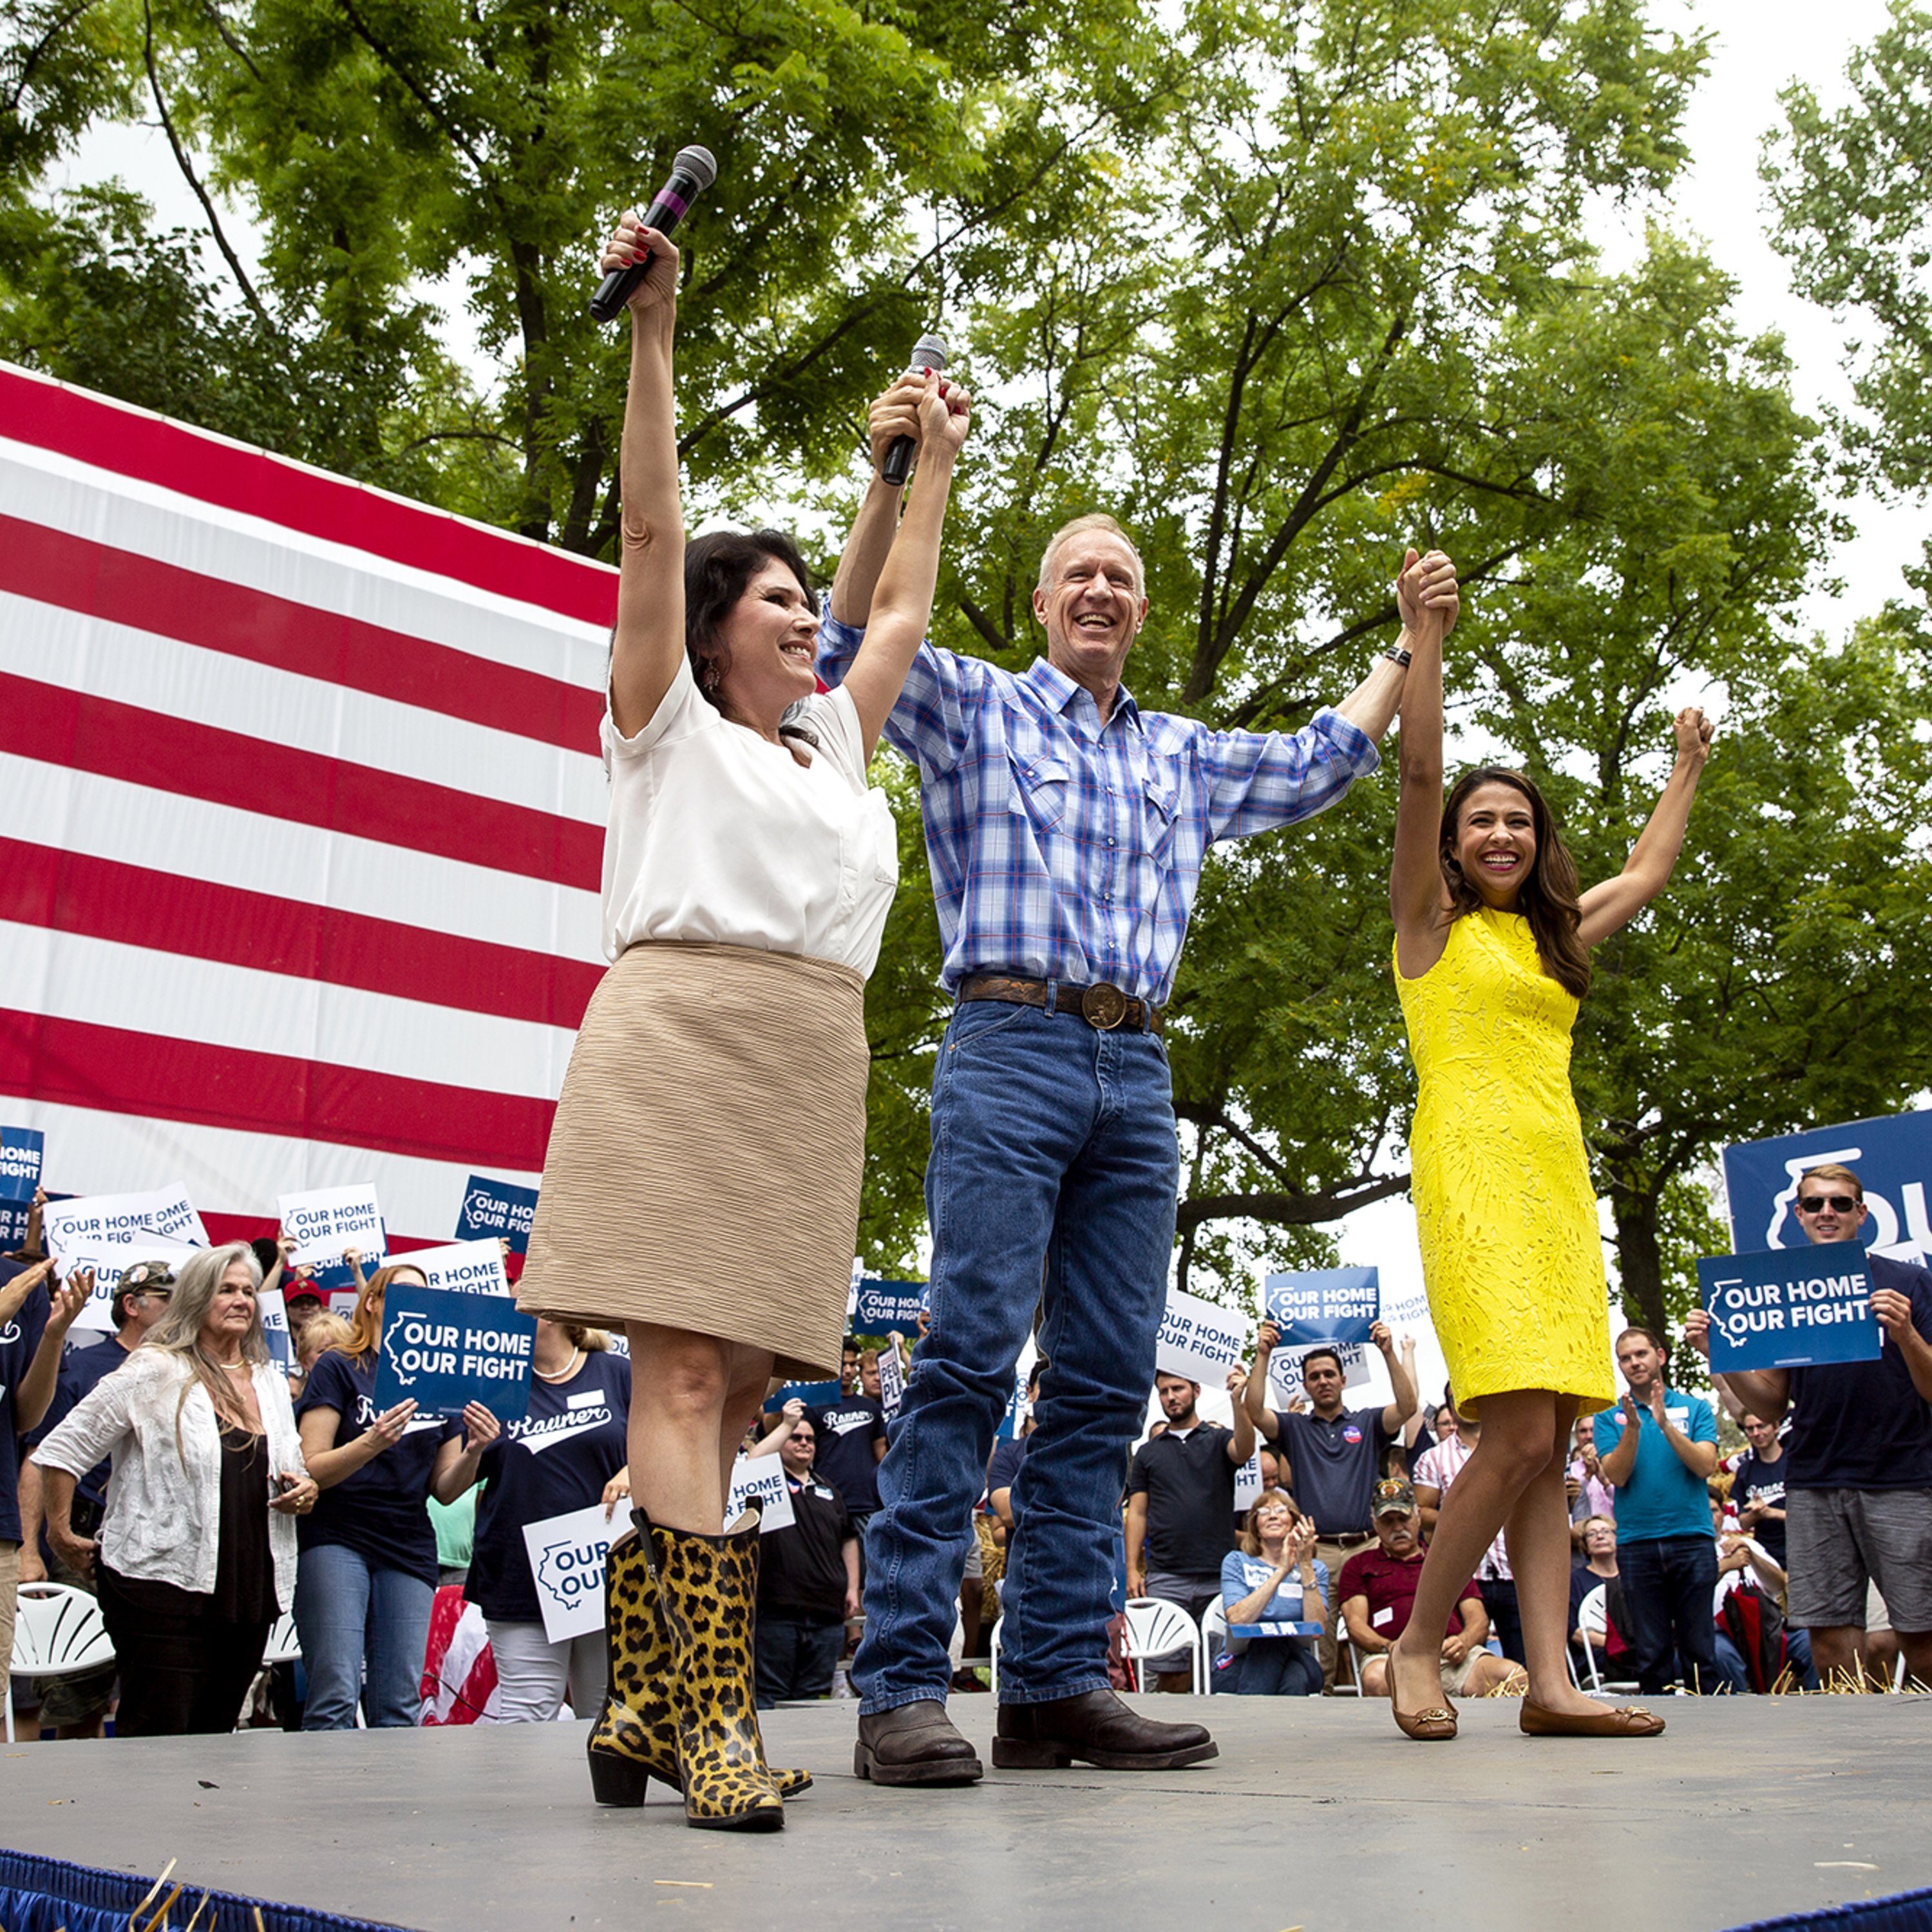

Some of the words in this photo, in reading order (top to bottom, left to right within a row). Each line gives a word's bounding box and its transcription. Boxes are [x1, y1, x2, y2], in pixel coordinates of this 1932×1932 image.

[0, 1161, 39, 1180] IGHT
[156, 1199, 190, 1222] OME
[296, 1209, 329, 1225] OUR
[334, 1202, 376, 1219] HOME
[476, 1196, 509, 1215] OUR
[511, 1204, 534, 1219] HO
[62, 1218, 100, 1234] OUR
[106, 1213, 153, 1229] HOME
[298, 1224, 332, 1240] OUR
[336, 1217, 377, 1234] FIGHT
[473, 1210, 506, 1228] OUR
[507, 1218, 531, 1233] FIG
[446, 1262, 499, 1283] HOME
[867, 1295, 896, 1308] OUR
[1279, 1290, 1319, 1306] OUR
[1323, 1288, 1377, 1303] HOME
[1395, 1294, 1426, 1311] HOM
[1725, 1283, 1782, 1309] OUR
[1786, 1273, 1868, 1302] HOME
[866, 1307, 895, 1320] OUR
[896, 1309, 921, 1320] FIGH
[1280, 1306, 1320, 1321] OUR
[1324, 1304, 1377, 1320] FIGHT
[1400, 1306, 1429, 1321] FIGH
[1728, 1309, 1785, 1334] OUR
[1791, 1299, 1870, 1328] FIGHT
[404, 1322, 459, 1349] OUR
[464, 1329, 532, 1356] HOME
[1162, 1311, 1193, 1332] OUR
[1195, 1323, 1240, 1351] HOME
[1157, 1327, 1187, 1349] OUR
[1190, 1340, 1236, 1366] FIGHT
[1330, 1343, 1361, 1353] OME
[401, 1349, 457, 1374] OUR
[462, 1354, 528, 1381] FIGHT
[1280, 1356, 1303, 1371] OU
[507, 1407, 611, 1440] Rauner
[734, 1475, 782, 1499] HOME
[737, 1490, 783, 1514] FHT
[555, 1541, 611, 1571] OUR
